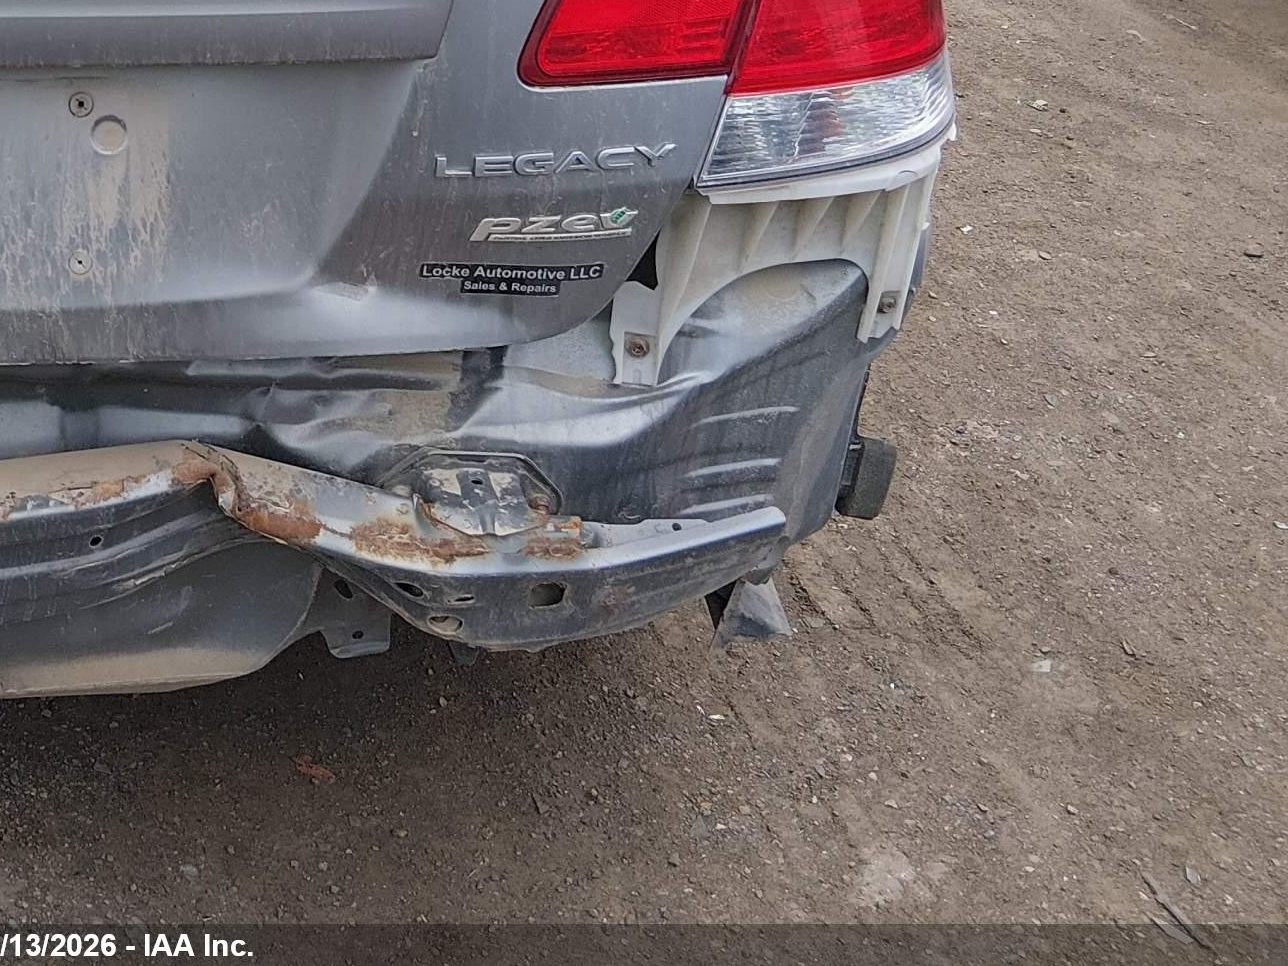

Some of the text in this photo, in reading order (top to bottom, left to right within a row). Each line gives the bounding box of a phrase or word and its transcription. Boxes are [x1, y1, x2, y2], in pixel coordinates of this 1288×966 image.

[434, 142, 677, 178] LEGACY
[422, 265, 601, 280] Locke Automotive LLC
[463, 281, 557, 294] Sales & Repairs
